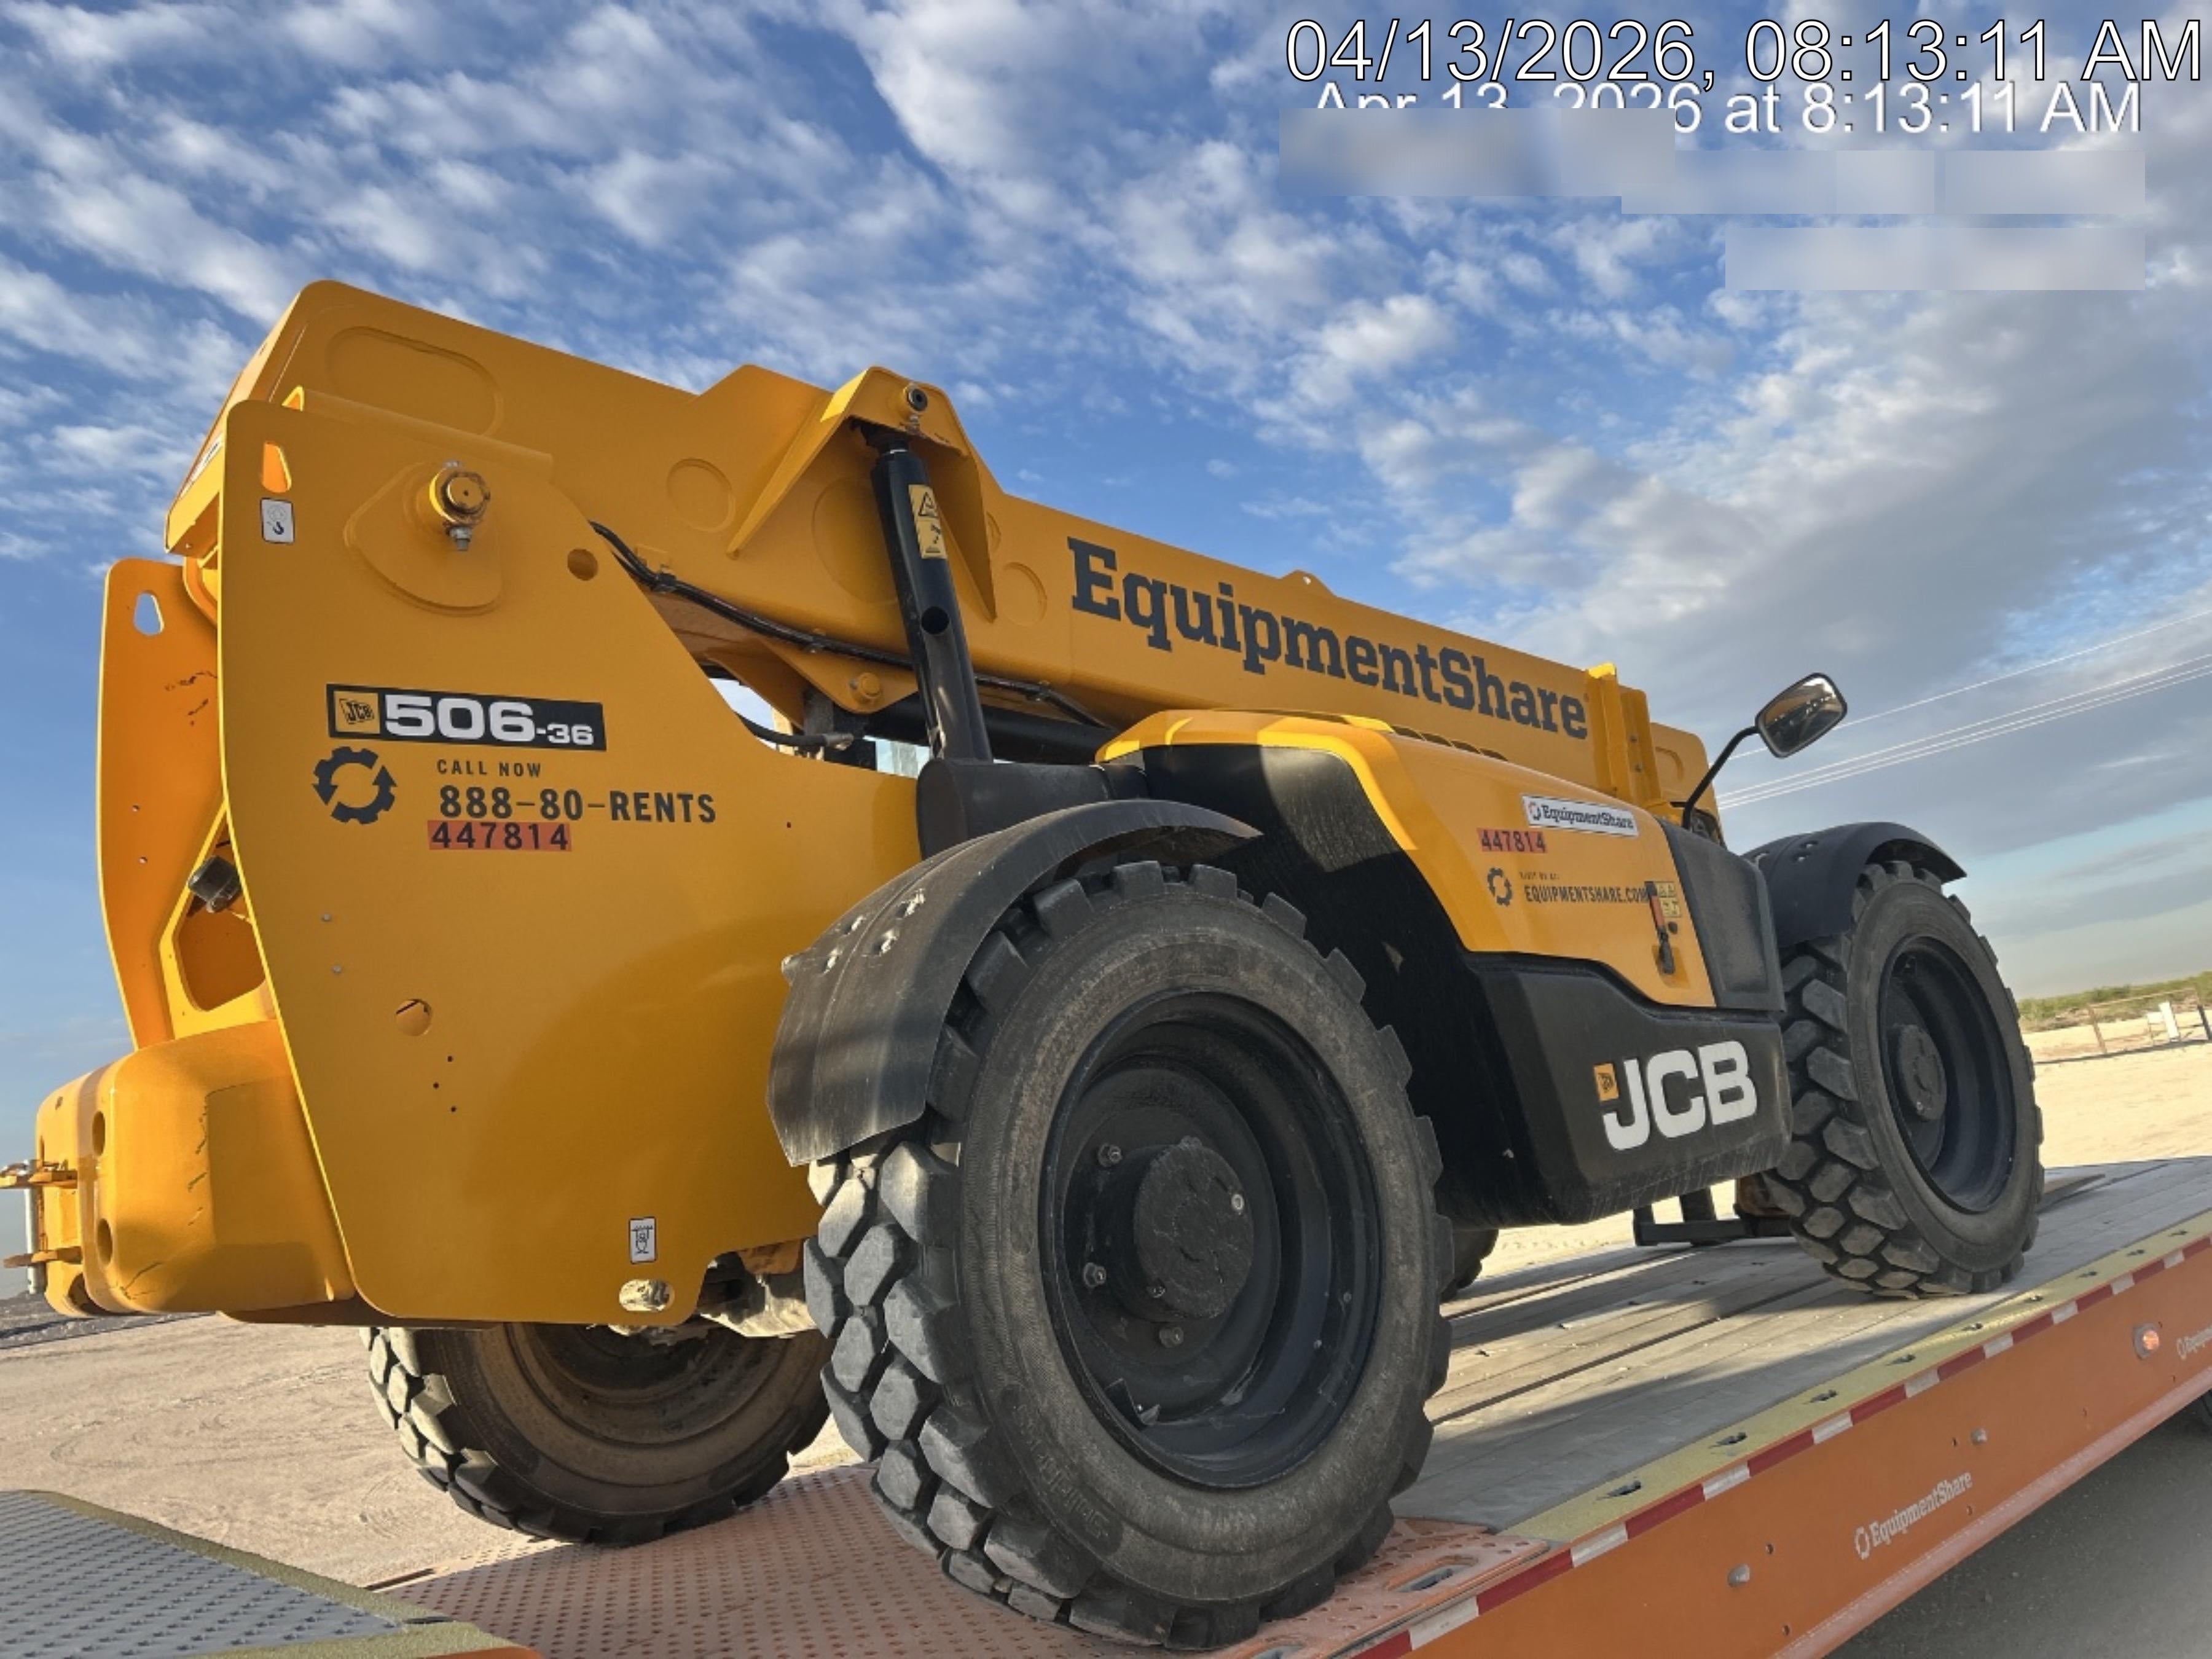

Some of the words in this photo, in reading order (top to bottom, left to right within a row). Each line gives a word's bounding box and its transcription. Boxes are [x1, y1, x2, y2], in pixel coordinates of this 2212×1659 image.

[1067, 536, 1588, 739] EquipmentShare
[385, 694, 594, 745] 506-36
[436, 759, 488, 775] CALL
[499, 762, 541, 777] NOW
[439, 785, 716, 823] 888-80-RENTS
[1542, 805, 1634, 829] EquipmentShare
[431, 822, 568, 850] 447814
[1481, 830, 1547, 853] 447814
[1602, 1040, 1757, 1151] JCB
[1869, 1472, 1973, 1547] EquipmentShare
